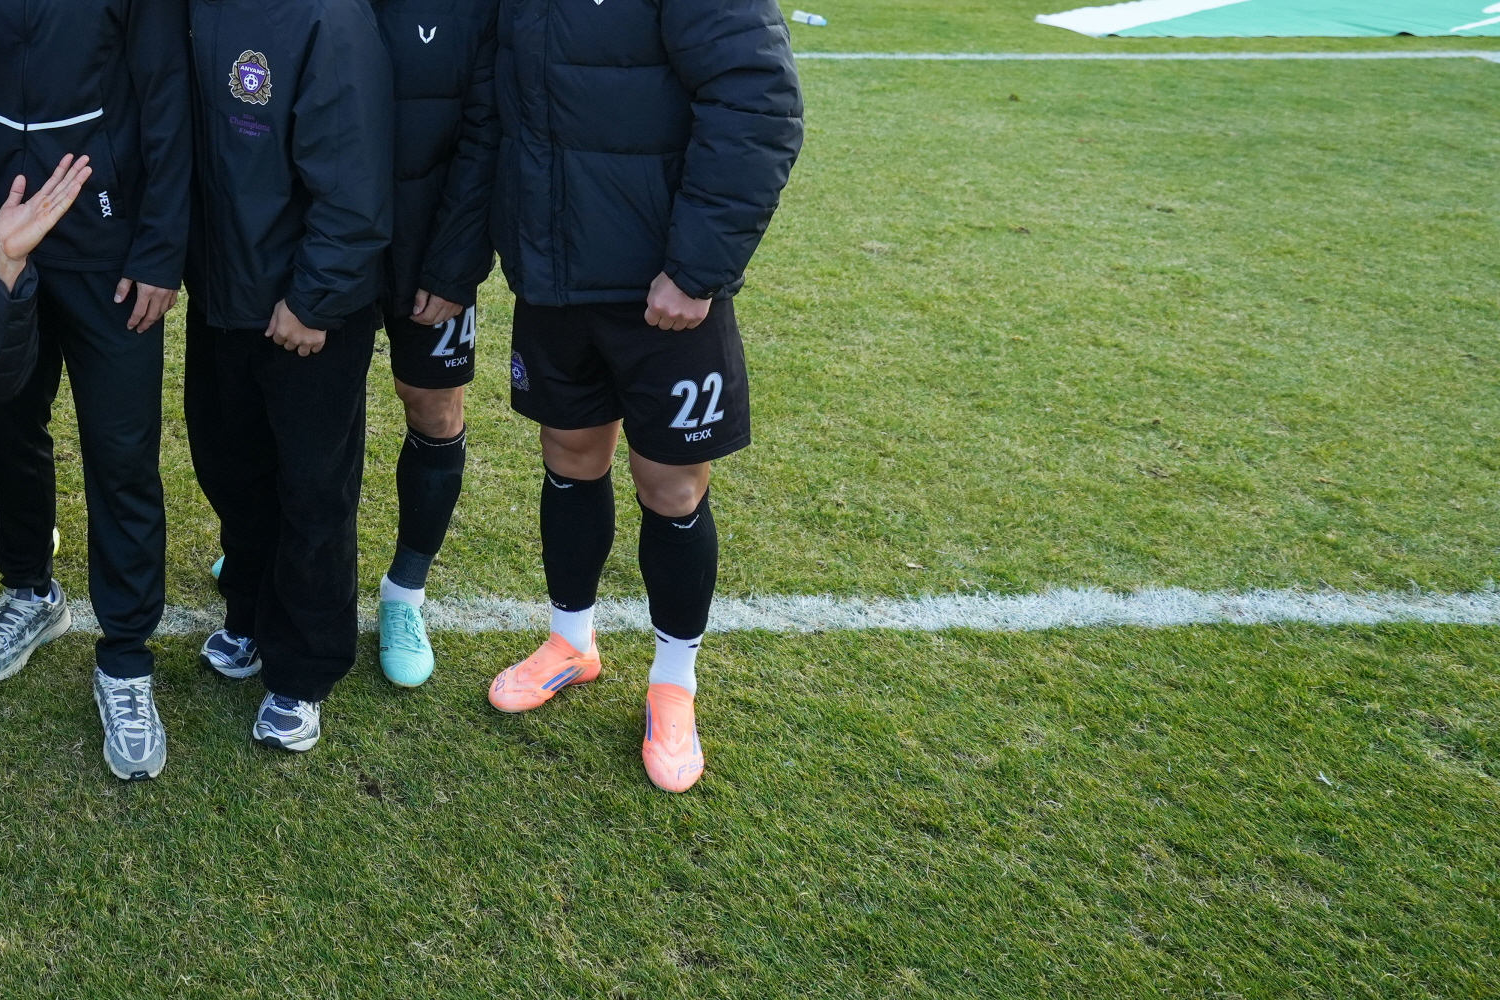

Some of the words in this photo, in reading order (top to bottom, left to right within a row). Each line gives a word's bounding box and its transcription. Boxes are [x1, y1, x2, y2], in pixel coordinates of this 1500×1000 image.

[240, 65, 265, 76] ANYANG
[230, 116, 271, 133] Champions
[98, 190, 112, 218] VEXX
[430, 304, 476, 358] 24
[444, 355, 468, 368] VEXX
[668, 371, 724, 430] 22
[684, 427, 712, 443] VEXX
